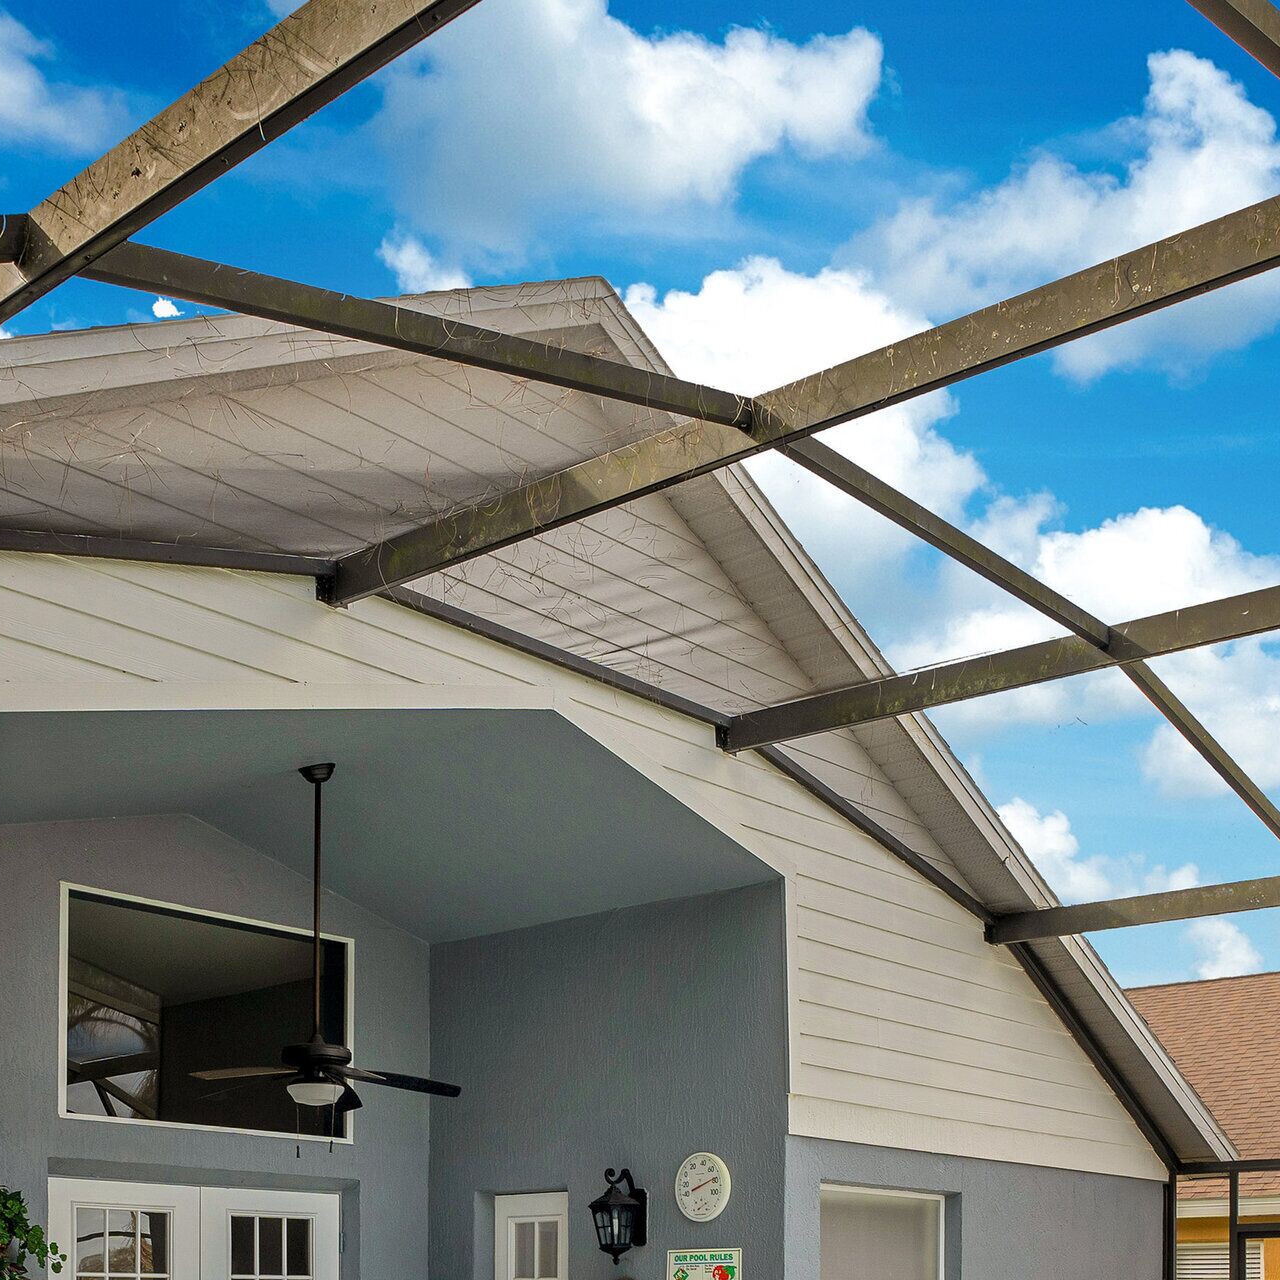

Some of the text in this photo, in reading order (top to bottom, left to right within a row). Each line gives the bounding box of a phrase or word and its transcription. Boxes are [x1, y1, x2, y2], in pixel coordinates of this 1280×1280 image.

[710, 1188, 719, 1196] 100
[674, 1253, 733, 1262] OUR POOL RULES
